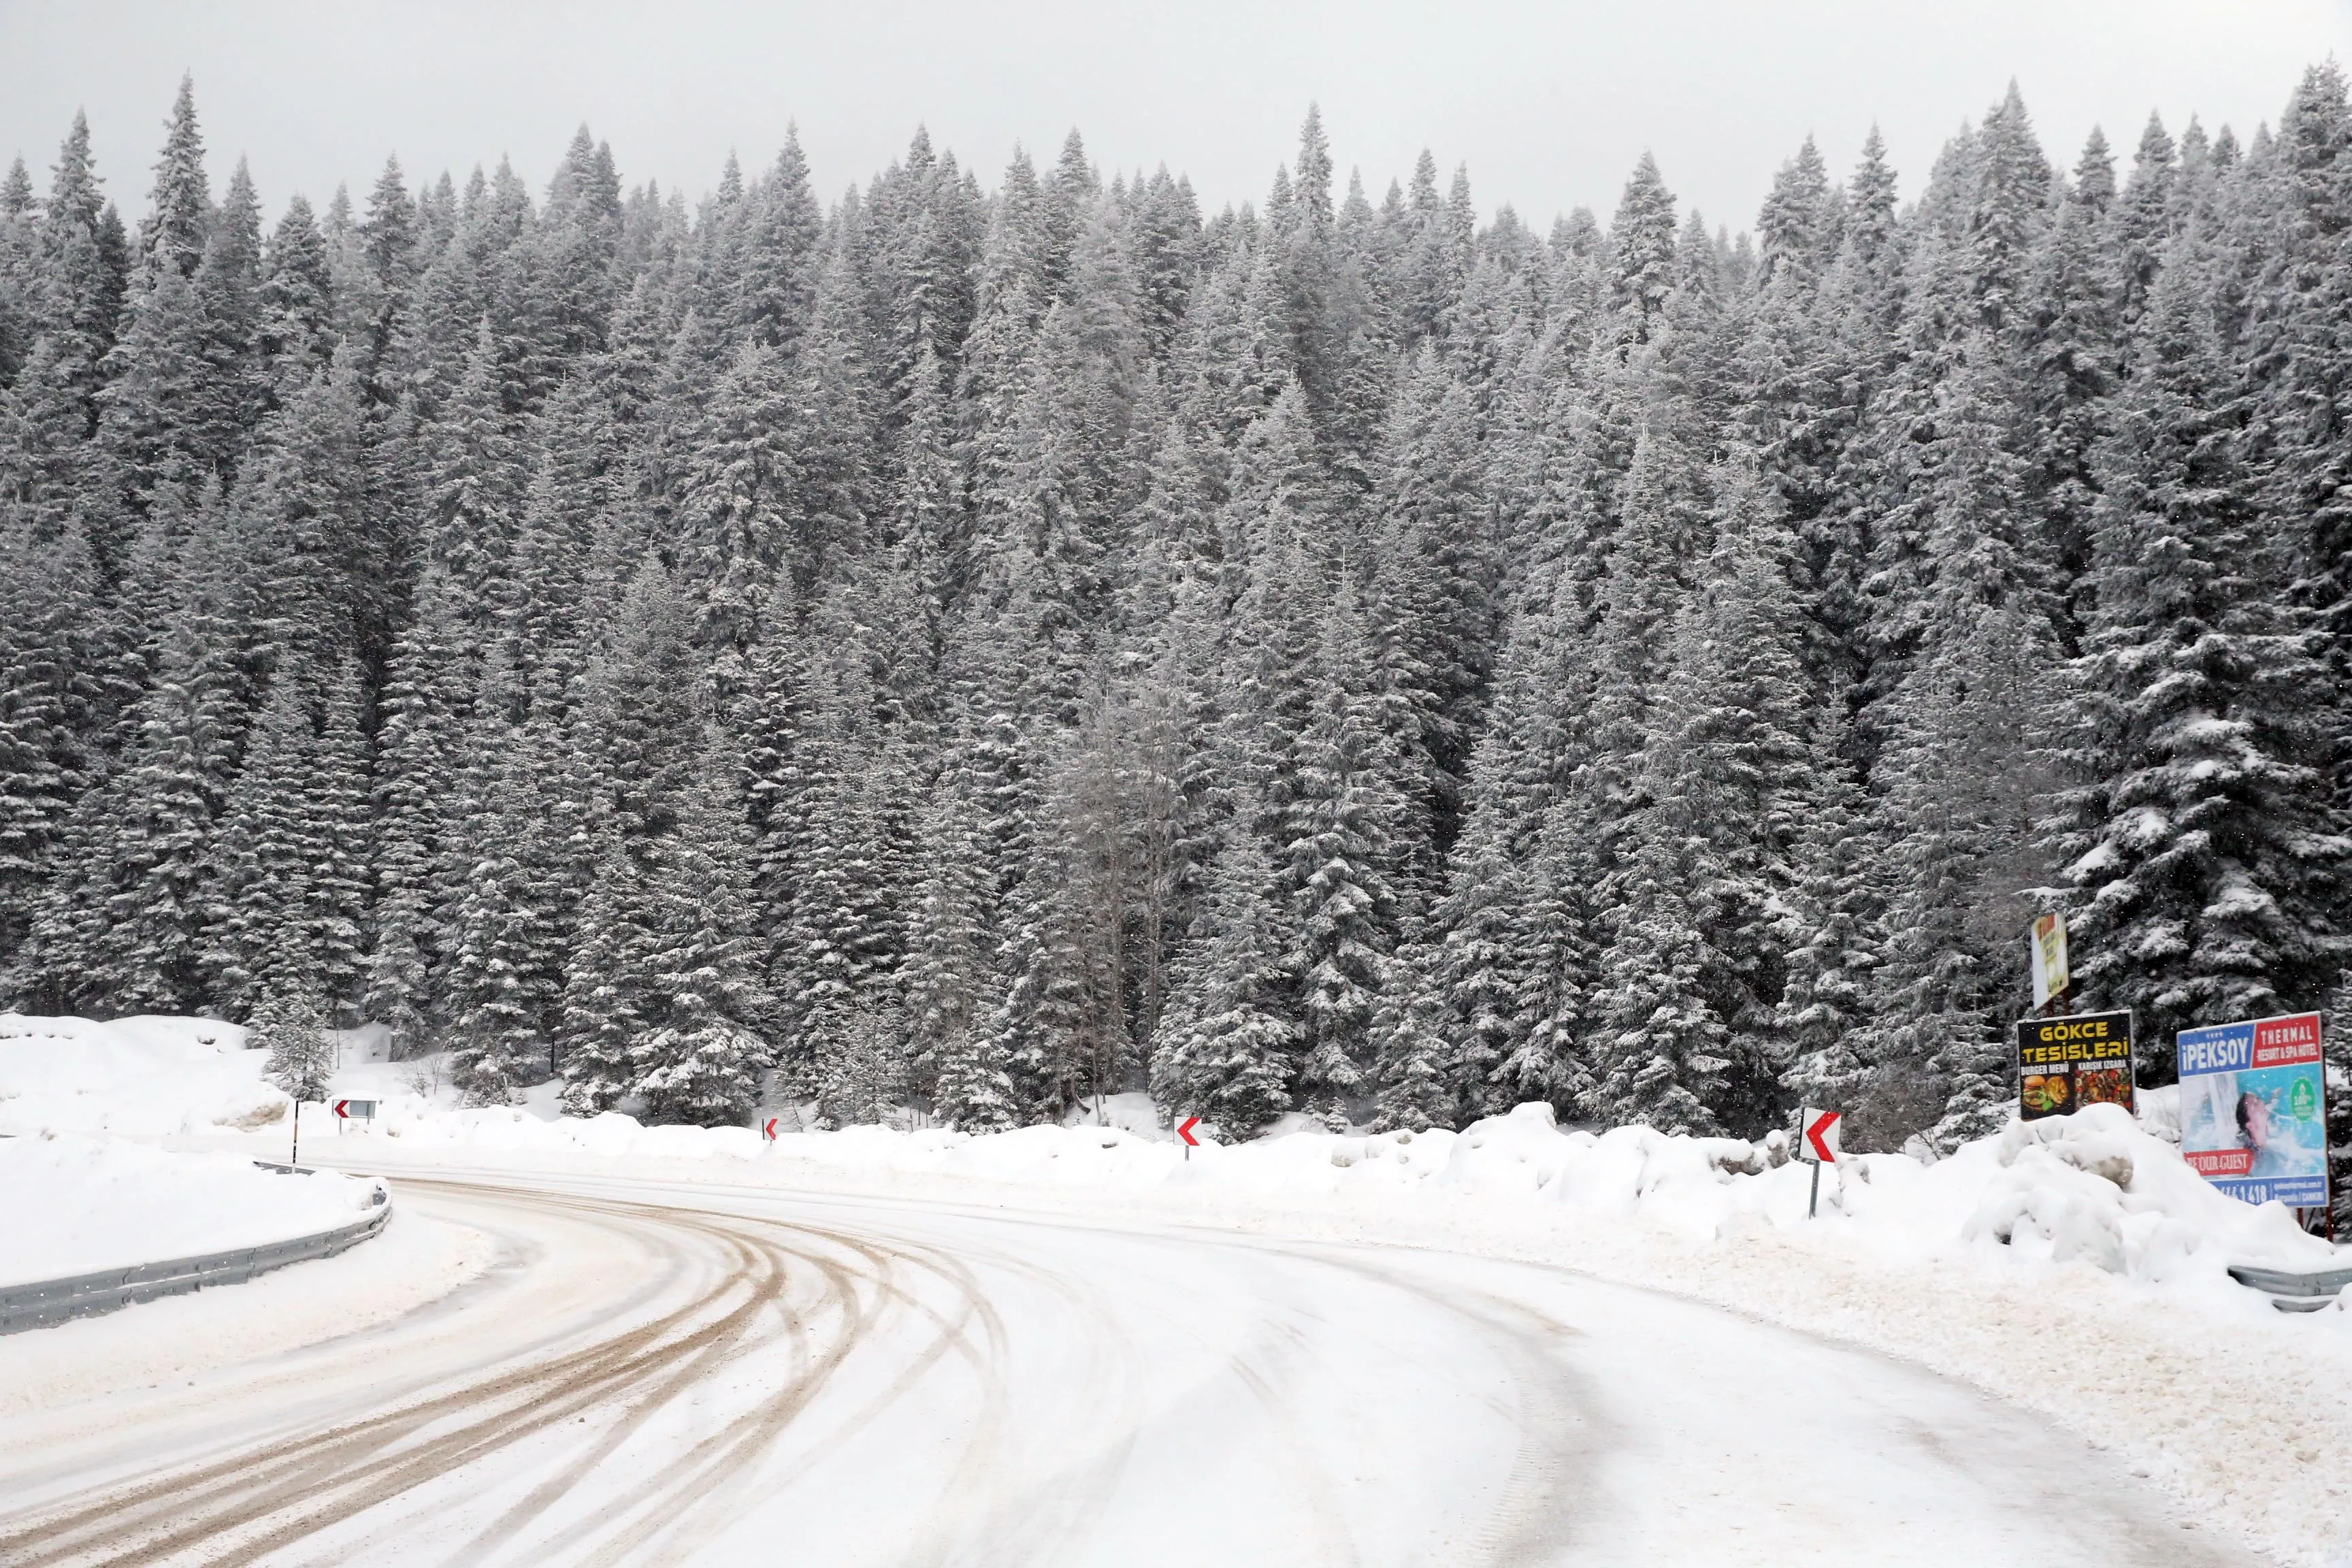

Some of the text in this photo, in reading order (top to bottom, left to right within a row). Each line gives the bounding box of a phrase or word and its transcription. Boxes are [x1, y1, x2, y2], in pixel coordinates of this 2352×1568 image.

[2040, 1021, 2108, 1041] GÖKCE
[2261, 1025, 2313, 1045] THERMAL
[2023, 1036, 2129, 1063] TESİSLERİ
[2257, 1047, 2280, 1062] RESORT
[2285, 1045, 2298, 1059] SPA
[2298, 1043, 2318, 1057] HOTEL
[2021, 1061, 2069, 1075] BURGER MENÜ
[2199, 1156, 2219, 1171] OUR
[2220, 1154, 2248, 1170] GUEST
[2249, 1185, 2267, 1203] 418
